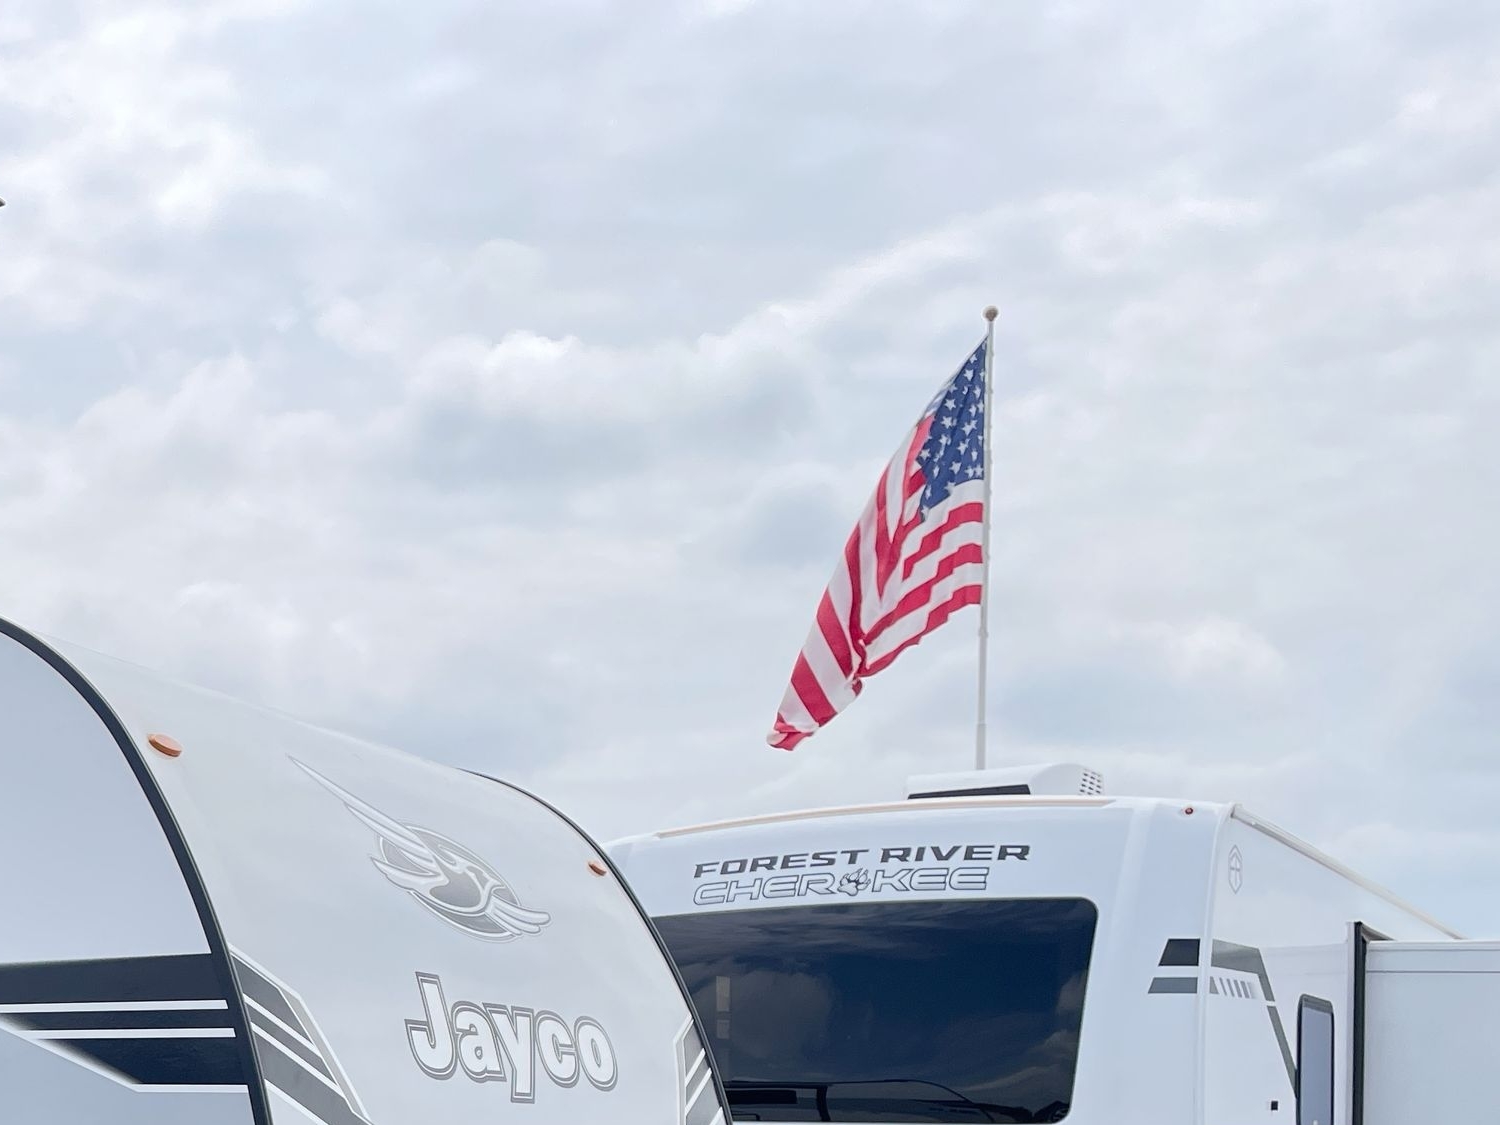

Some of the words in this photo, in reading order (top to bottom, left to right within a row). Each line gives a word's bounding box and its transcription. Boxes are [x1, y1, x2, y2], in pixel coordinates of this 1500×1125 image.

[693, 849, 870, 879] FOREST
[880, 844, 1031, 862] RIVER
[404, 971, 618, 1104] Jayco
